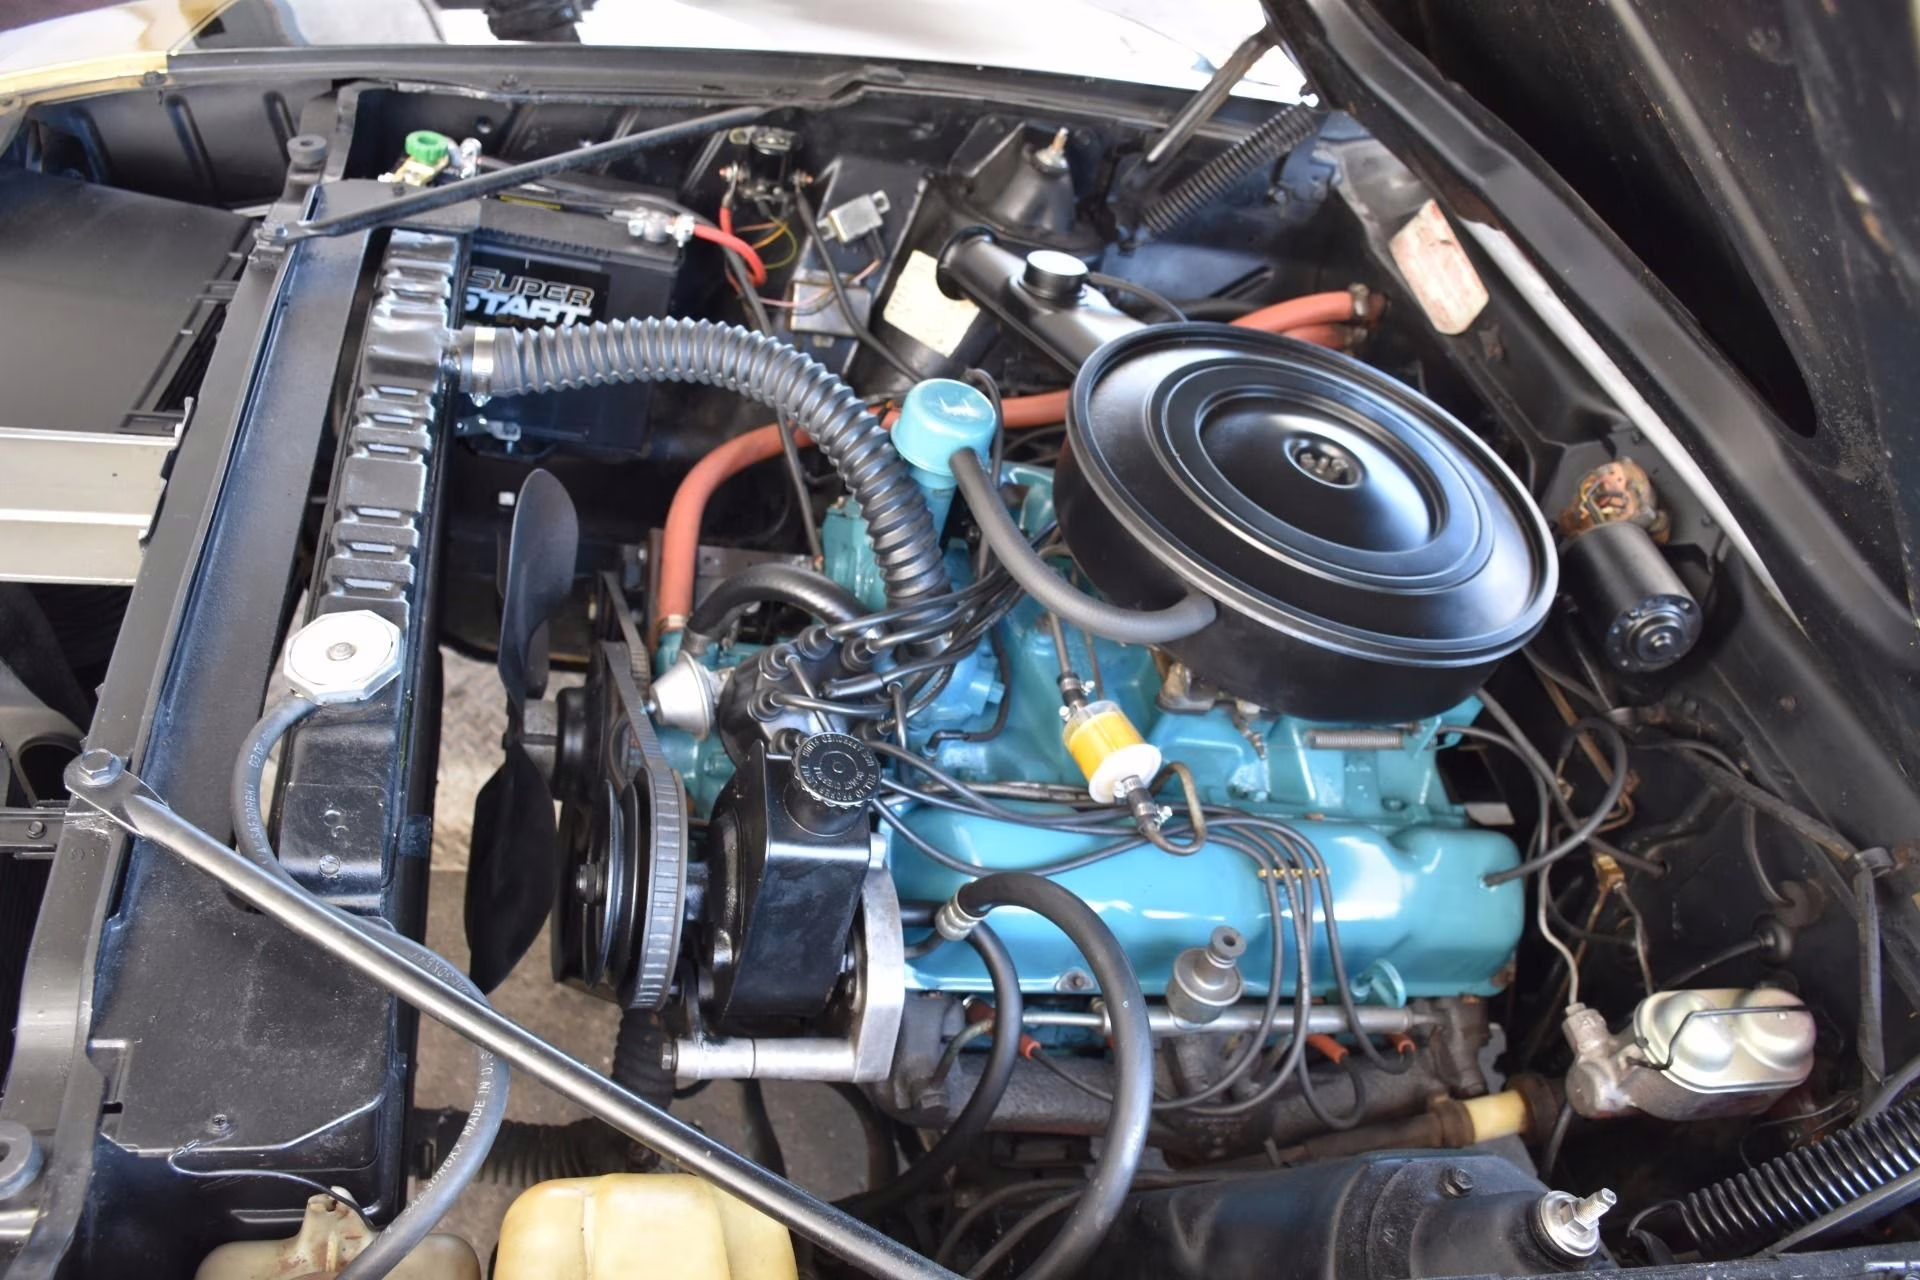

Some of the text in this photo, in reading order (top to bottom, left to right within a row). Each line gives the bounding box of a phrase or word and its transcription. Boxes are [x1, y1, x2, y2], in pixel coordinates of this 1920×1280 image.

[467, 266, 595, 307] SUPER
[462, 1100, 486, 1136] MADE
[478, 1080, 491, 1094] IN
